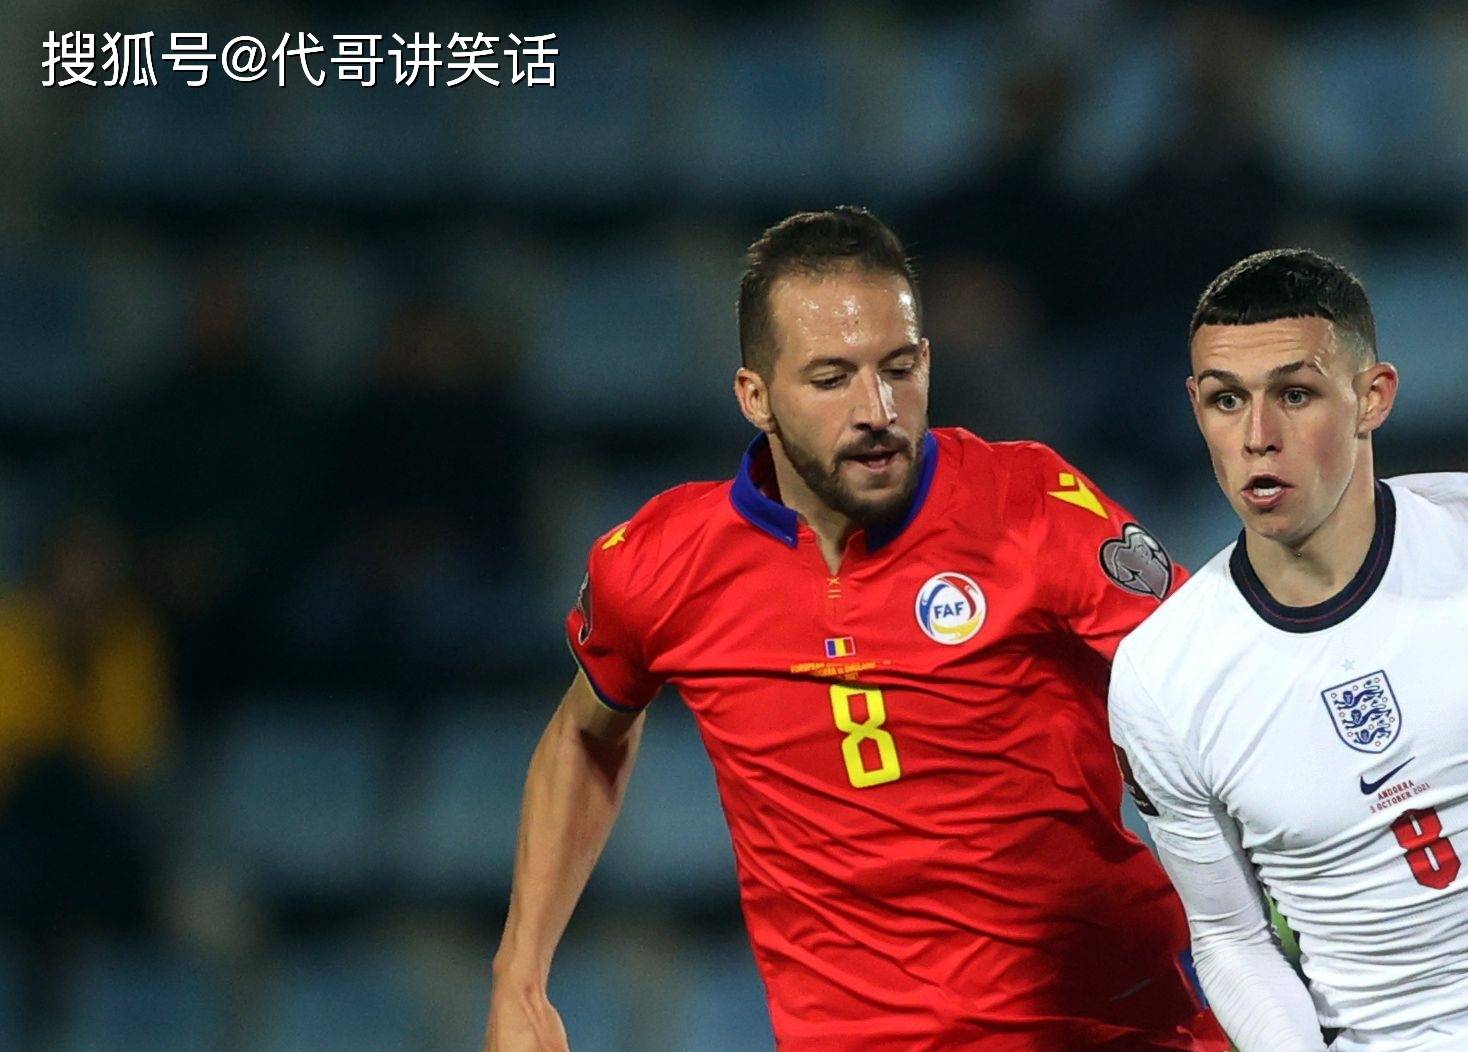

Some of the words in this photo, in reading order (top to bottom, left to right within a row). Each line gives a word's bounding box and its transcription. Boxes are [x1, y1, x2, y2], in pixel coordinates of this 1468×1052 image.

[934, 602, 963, 619] FAF
[830, 684, 900, 789] 8
[1376, 791, 1412, 811] OCTOBER
[1412, 782, 1432, 795] 2021
[1377, 780, 1415, 800] ANDORRA
[1389, 807, 1461, 890] 8
